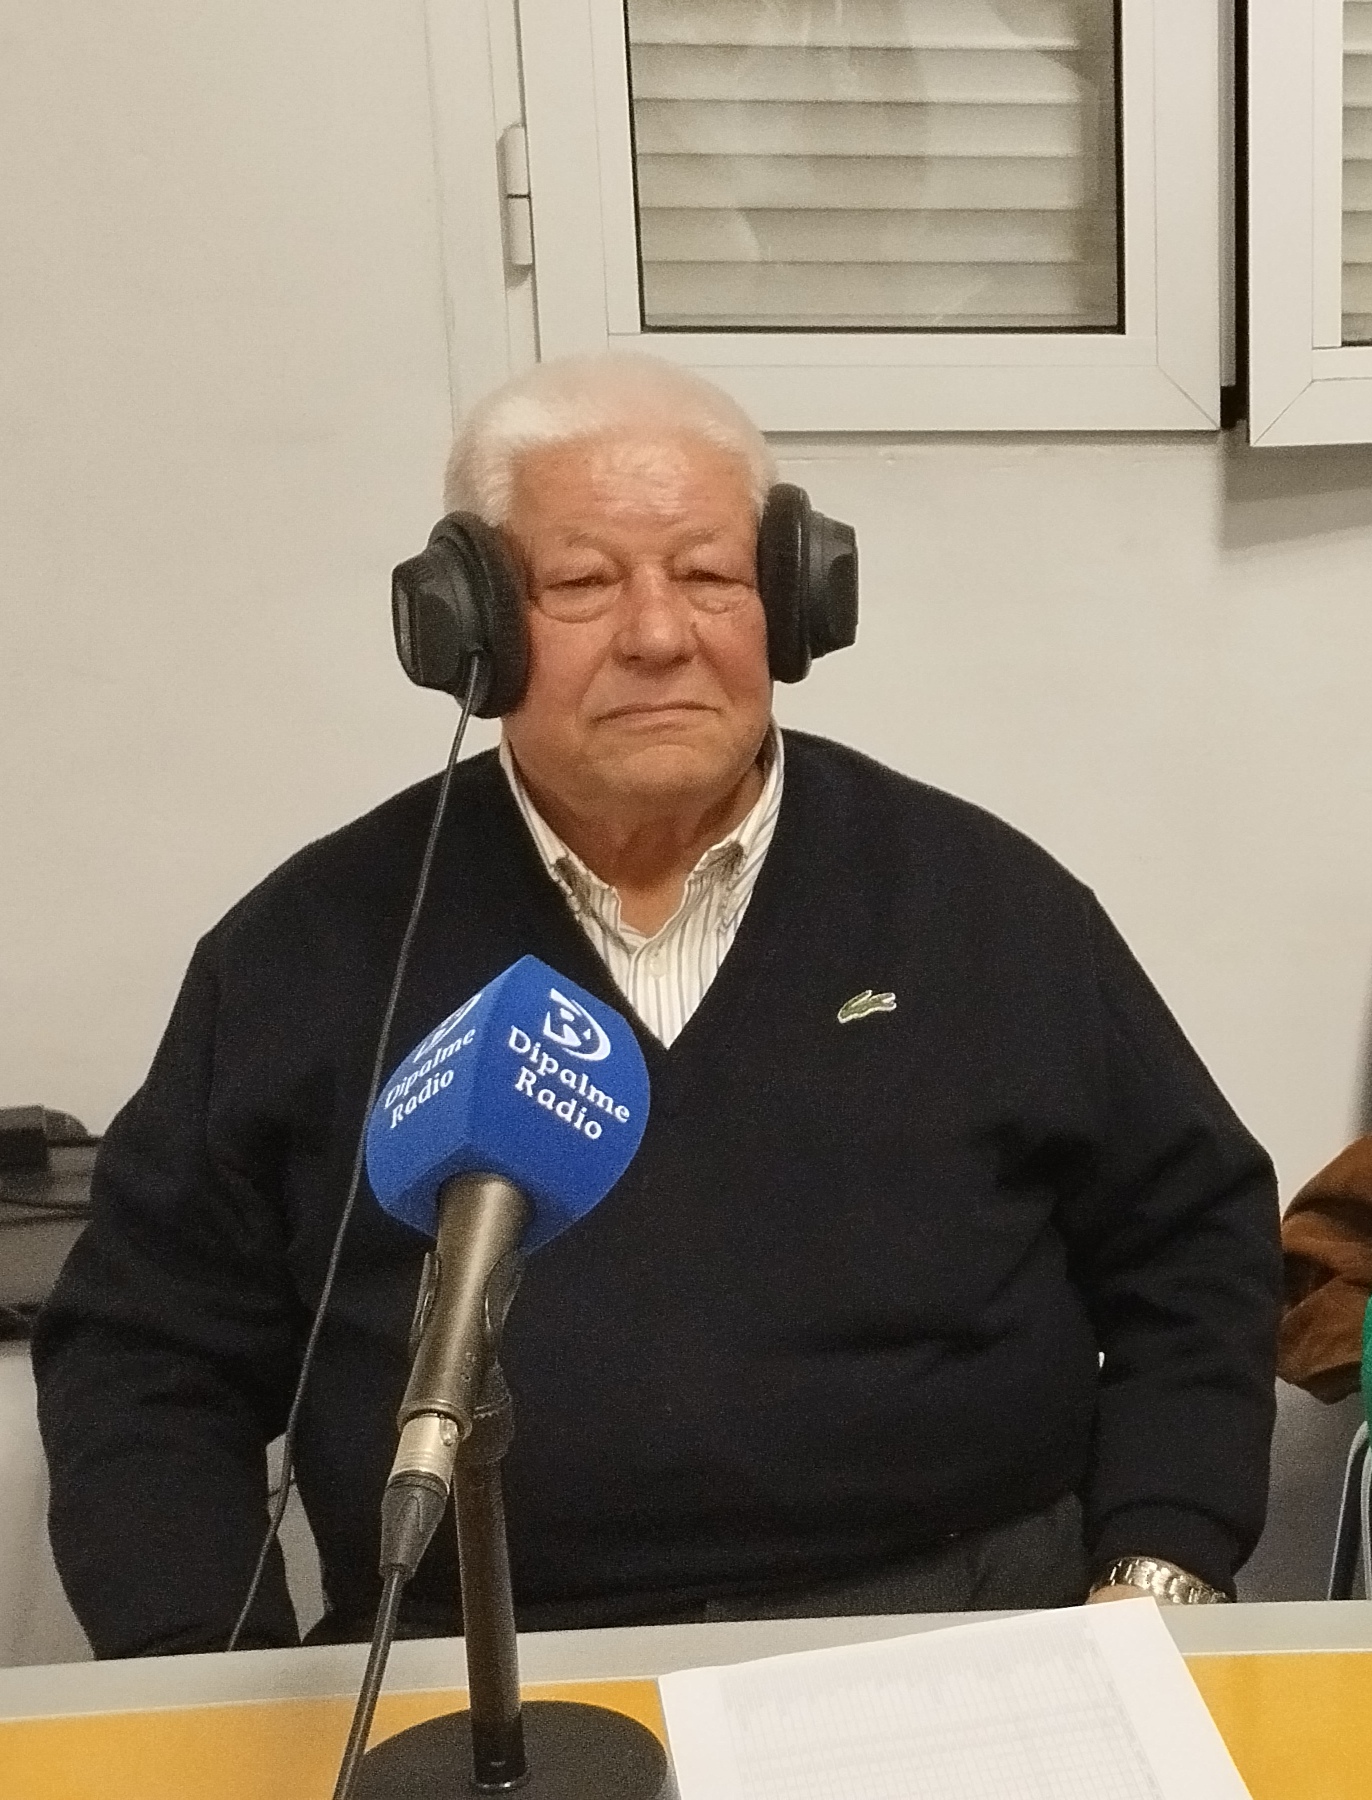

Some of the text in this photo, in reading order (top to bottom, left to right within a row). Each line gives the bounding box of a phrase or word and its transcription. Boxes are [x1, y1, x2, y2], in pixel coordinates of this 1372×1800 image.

[384, 1028, 476, 1109] Dipalme
[390, 1069, 454, 1129] Radio
[508, 1025, 630, 1123] Dipalme
[515, 1066, 602, 1139] Radio
